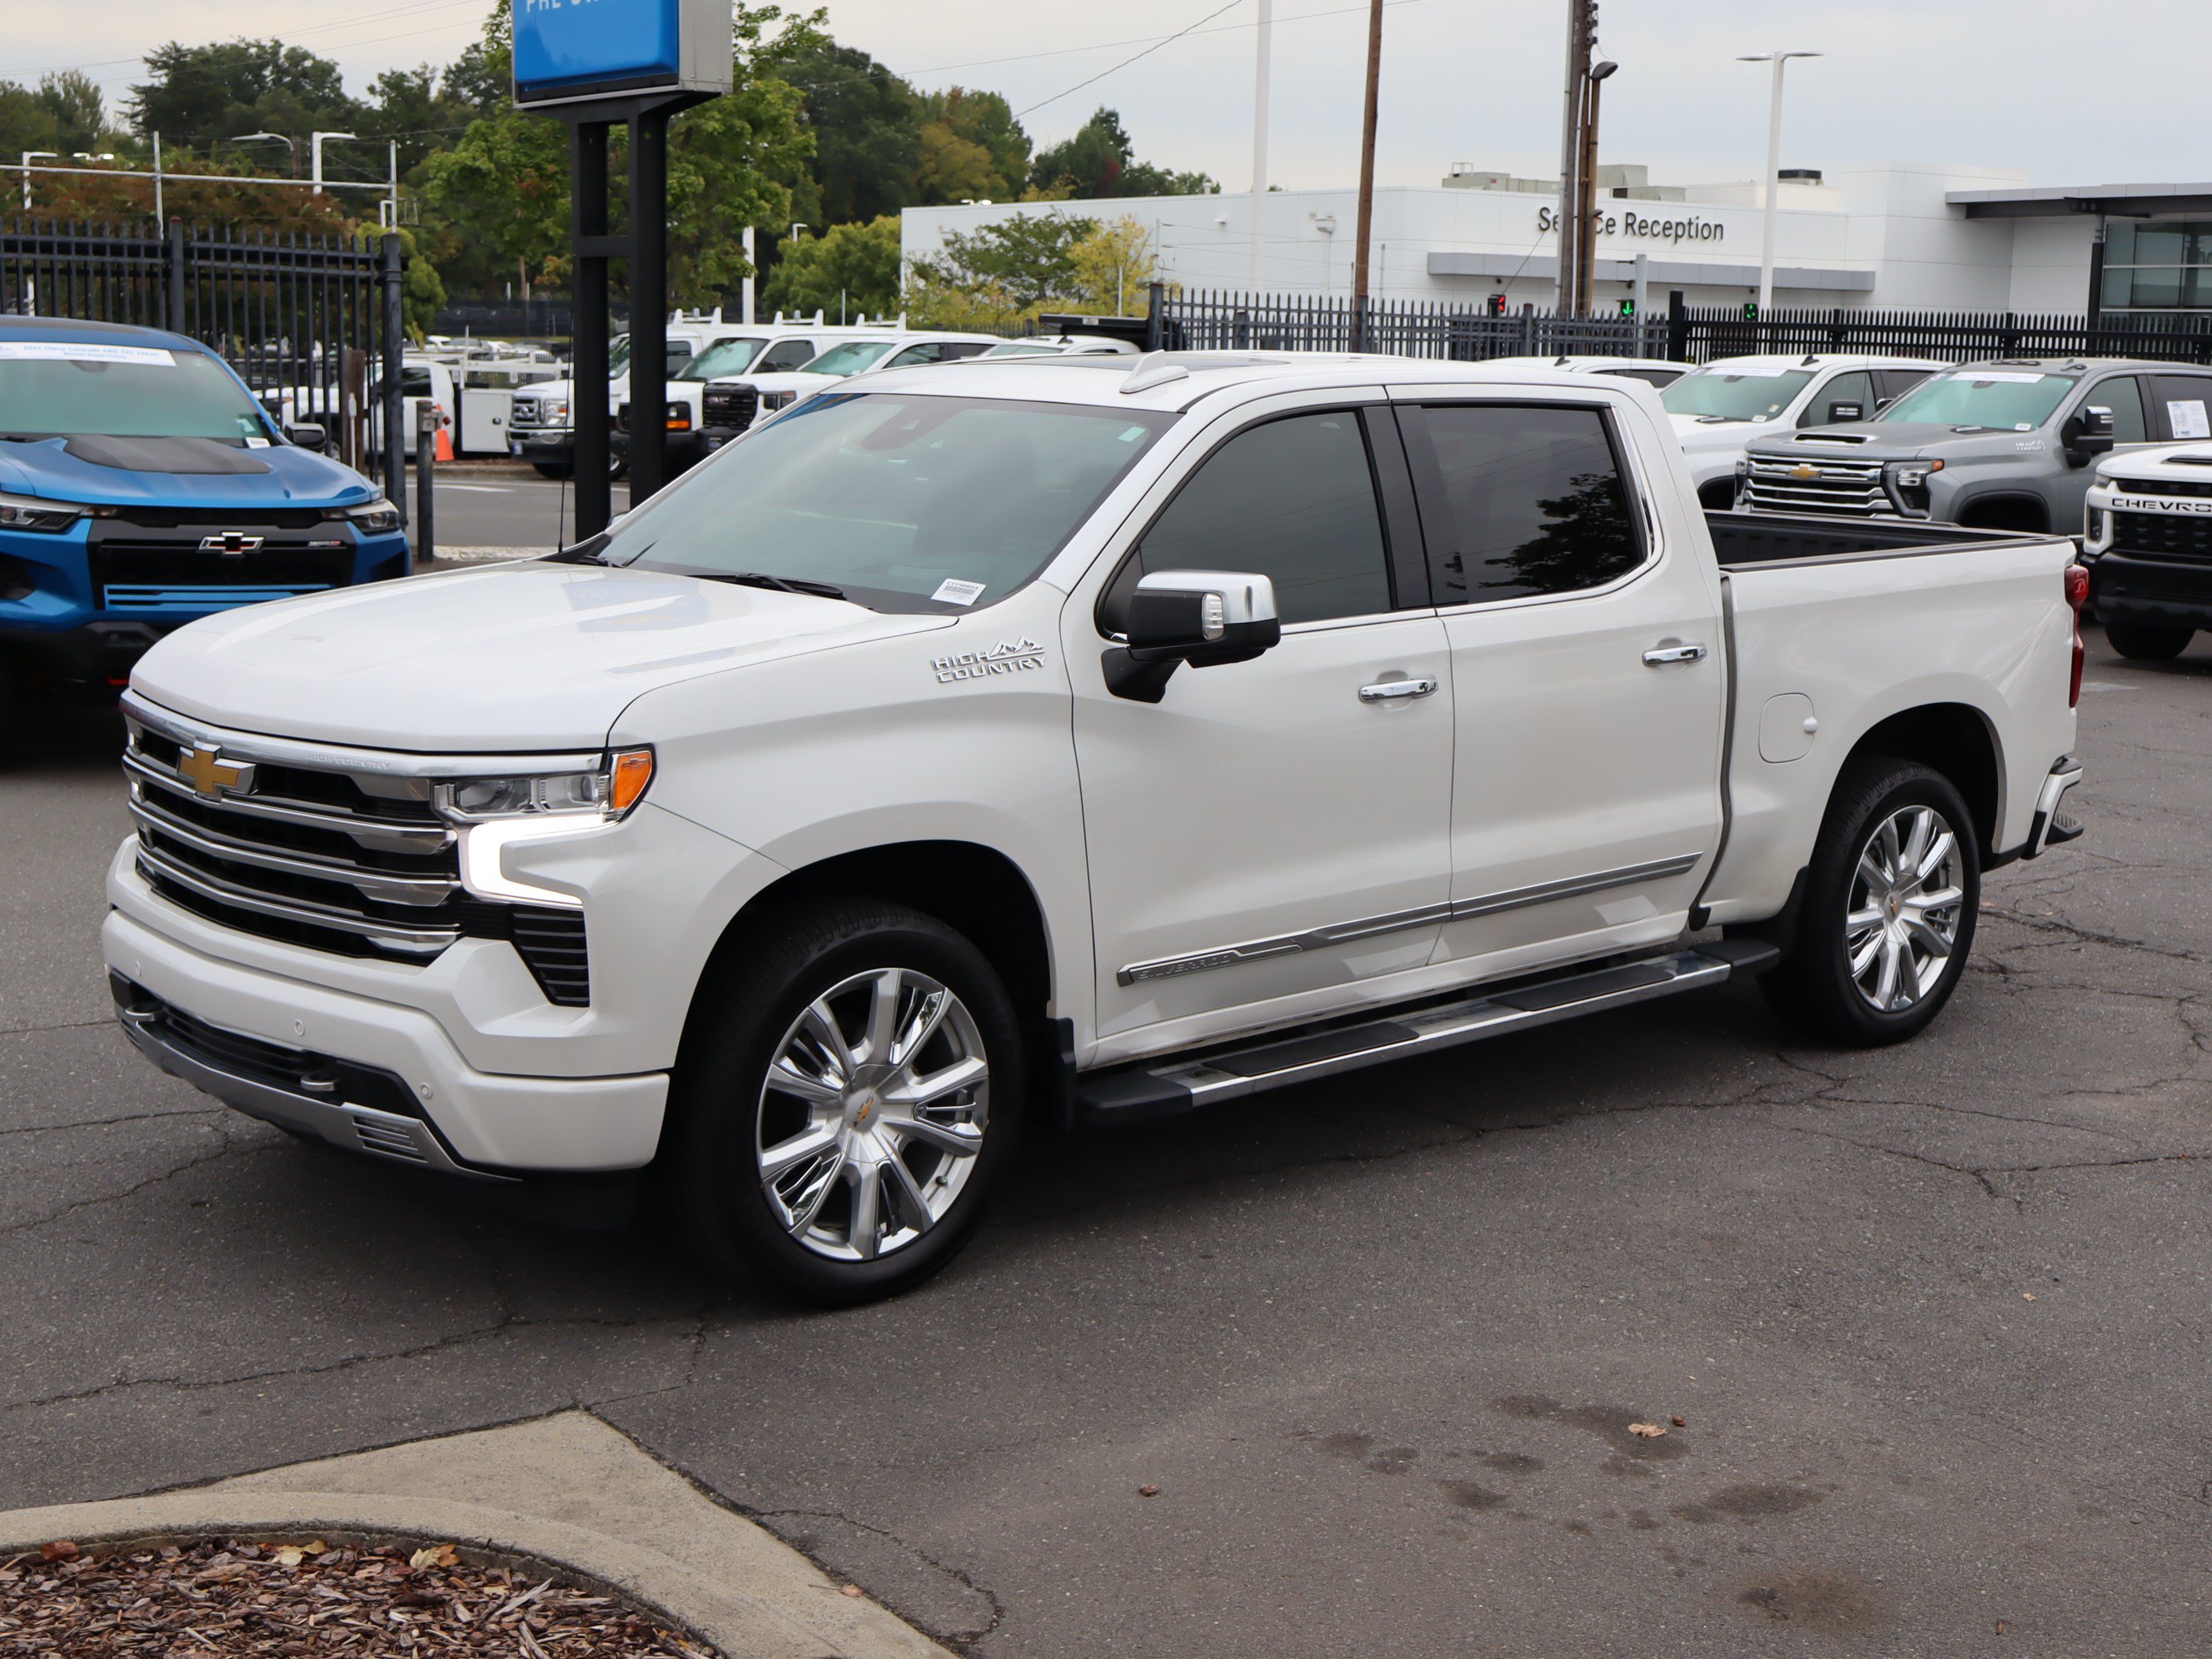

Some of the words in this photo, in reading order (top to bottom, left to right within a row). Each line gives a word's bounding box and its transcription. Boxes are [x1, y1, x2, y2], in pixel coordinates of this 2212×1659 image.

[1538, 207, 1617, 235] Sece
[1625, 212, 1724, 244] Reception
[2112, 498, 2212, 513] CHEVRO
[930, 651, 991, 670] HIGH
[936, 655, 1046, 683] COUNTRY
[307, 752, 333, 764] HIGH
[336, 755, 392, 770] COUNTRY
